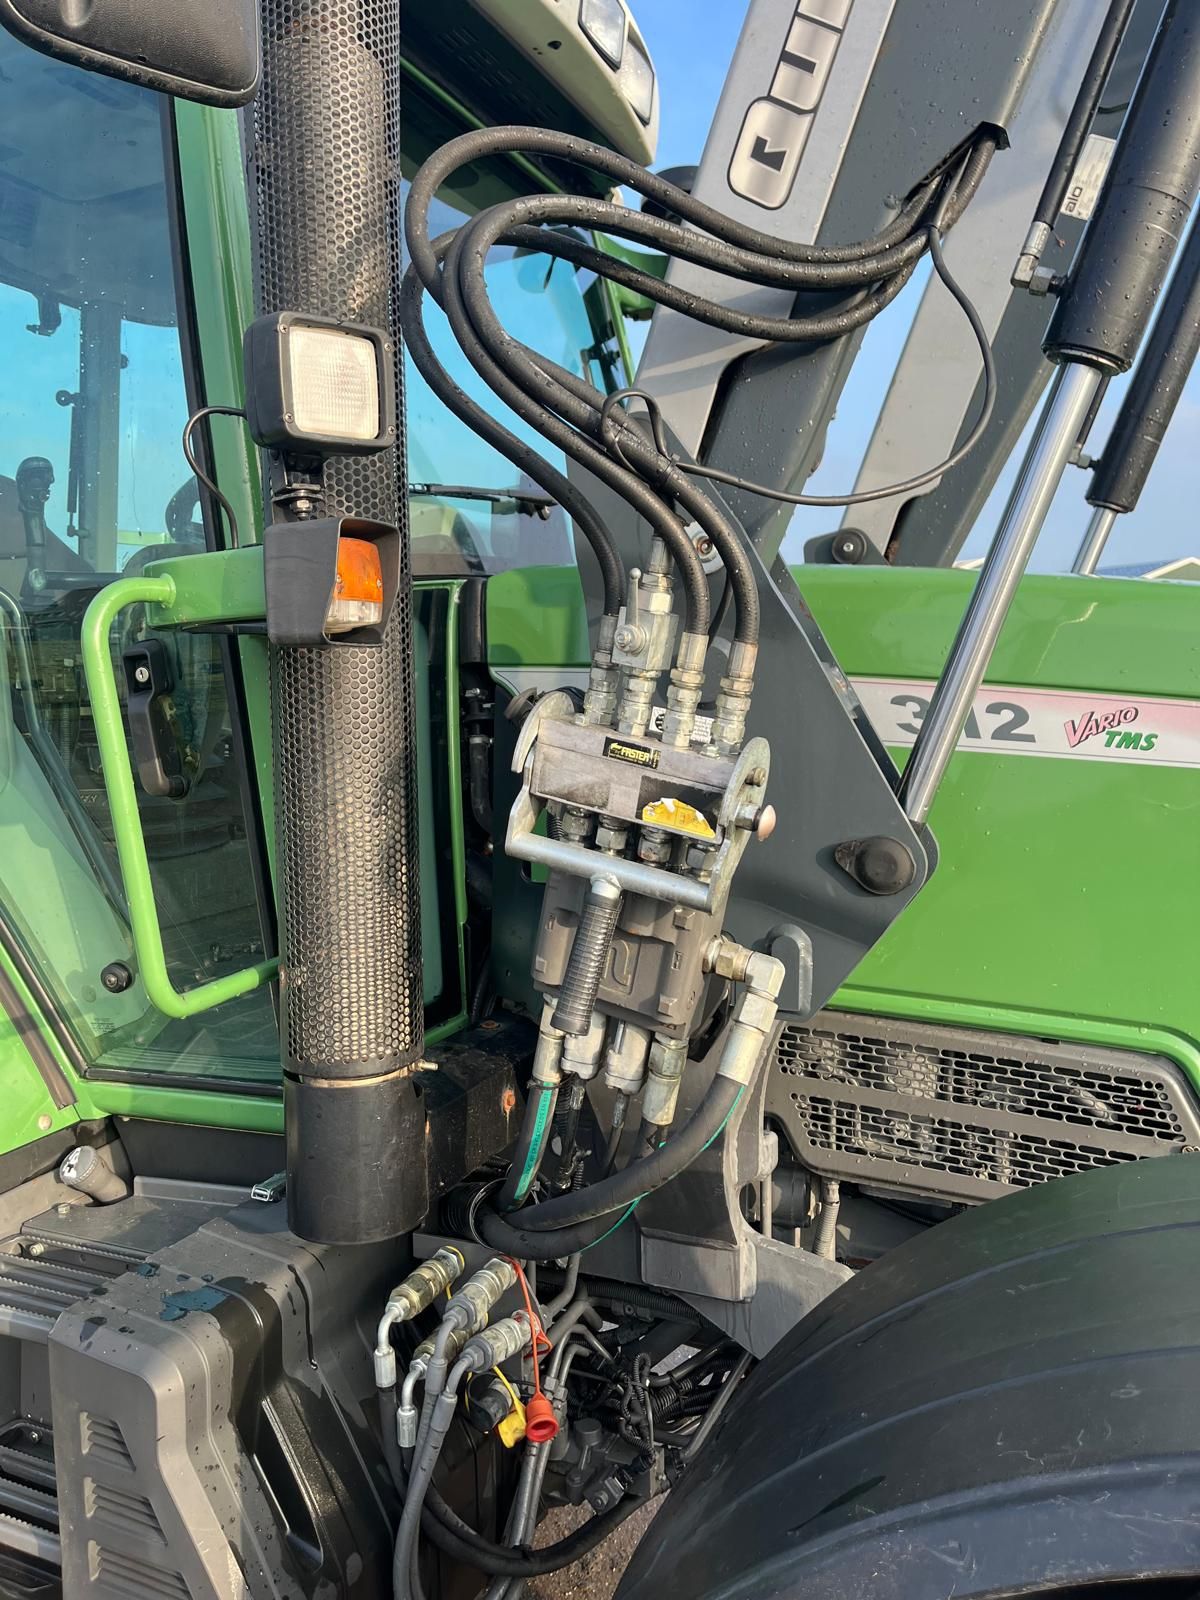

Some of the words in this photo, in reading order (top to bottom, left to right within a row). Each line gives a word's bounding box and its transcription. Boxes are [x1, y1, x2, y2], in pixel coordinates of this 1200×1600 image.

[1065, 186, 1083, 212] alo
[890, 694, 1036, 744] 32
[1063, 706, 1139, 748] VARIO
[1104, 730, 1159, 752] TMS
